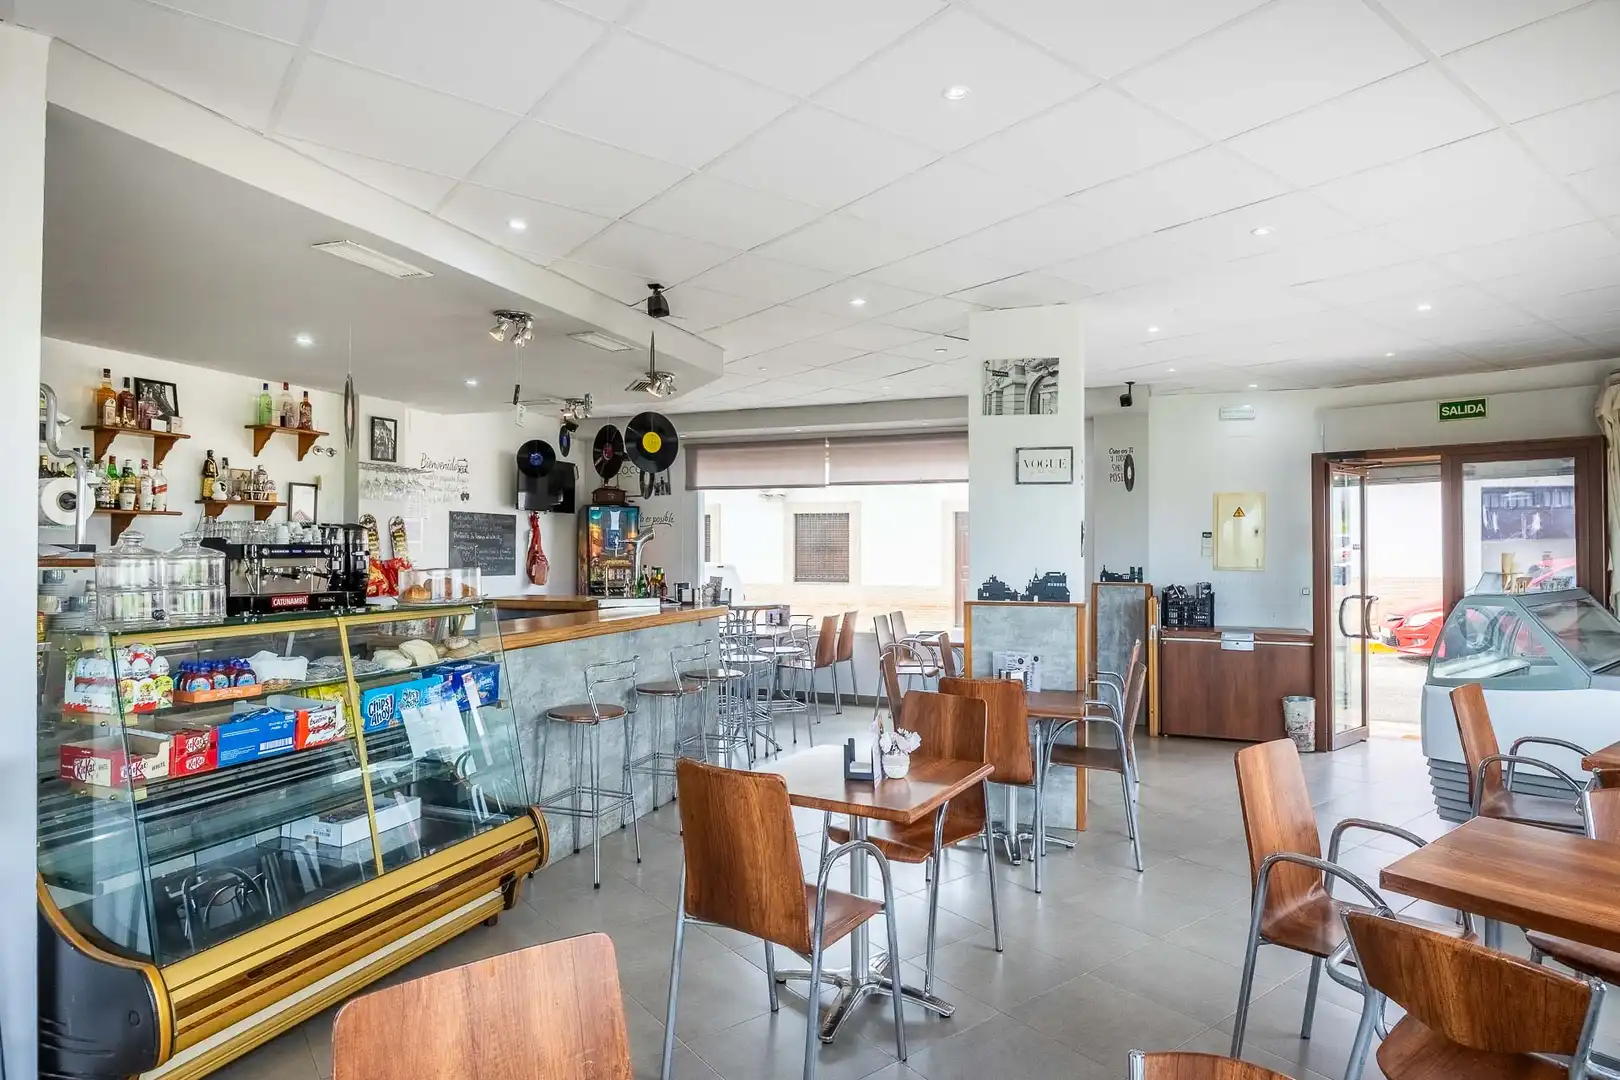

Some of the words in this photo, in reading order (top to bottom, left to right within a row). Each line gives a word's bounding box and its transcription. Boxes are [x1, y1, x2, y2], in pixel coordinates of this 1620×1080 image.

[1441, 404, 1485, 416] SALIDA
[1023, 459, 1067, 469] VOGUE
[151, 761, 166, 771] WHITE
[187, 757, 204, 768] KitKat
